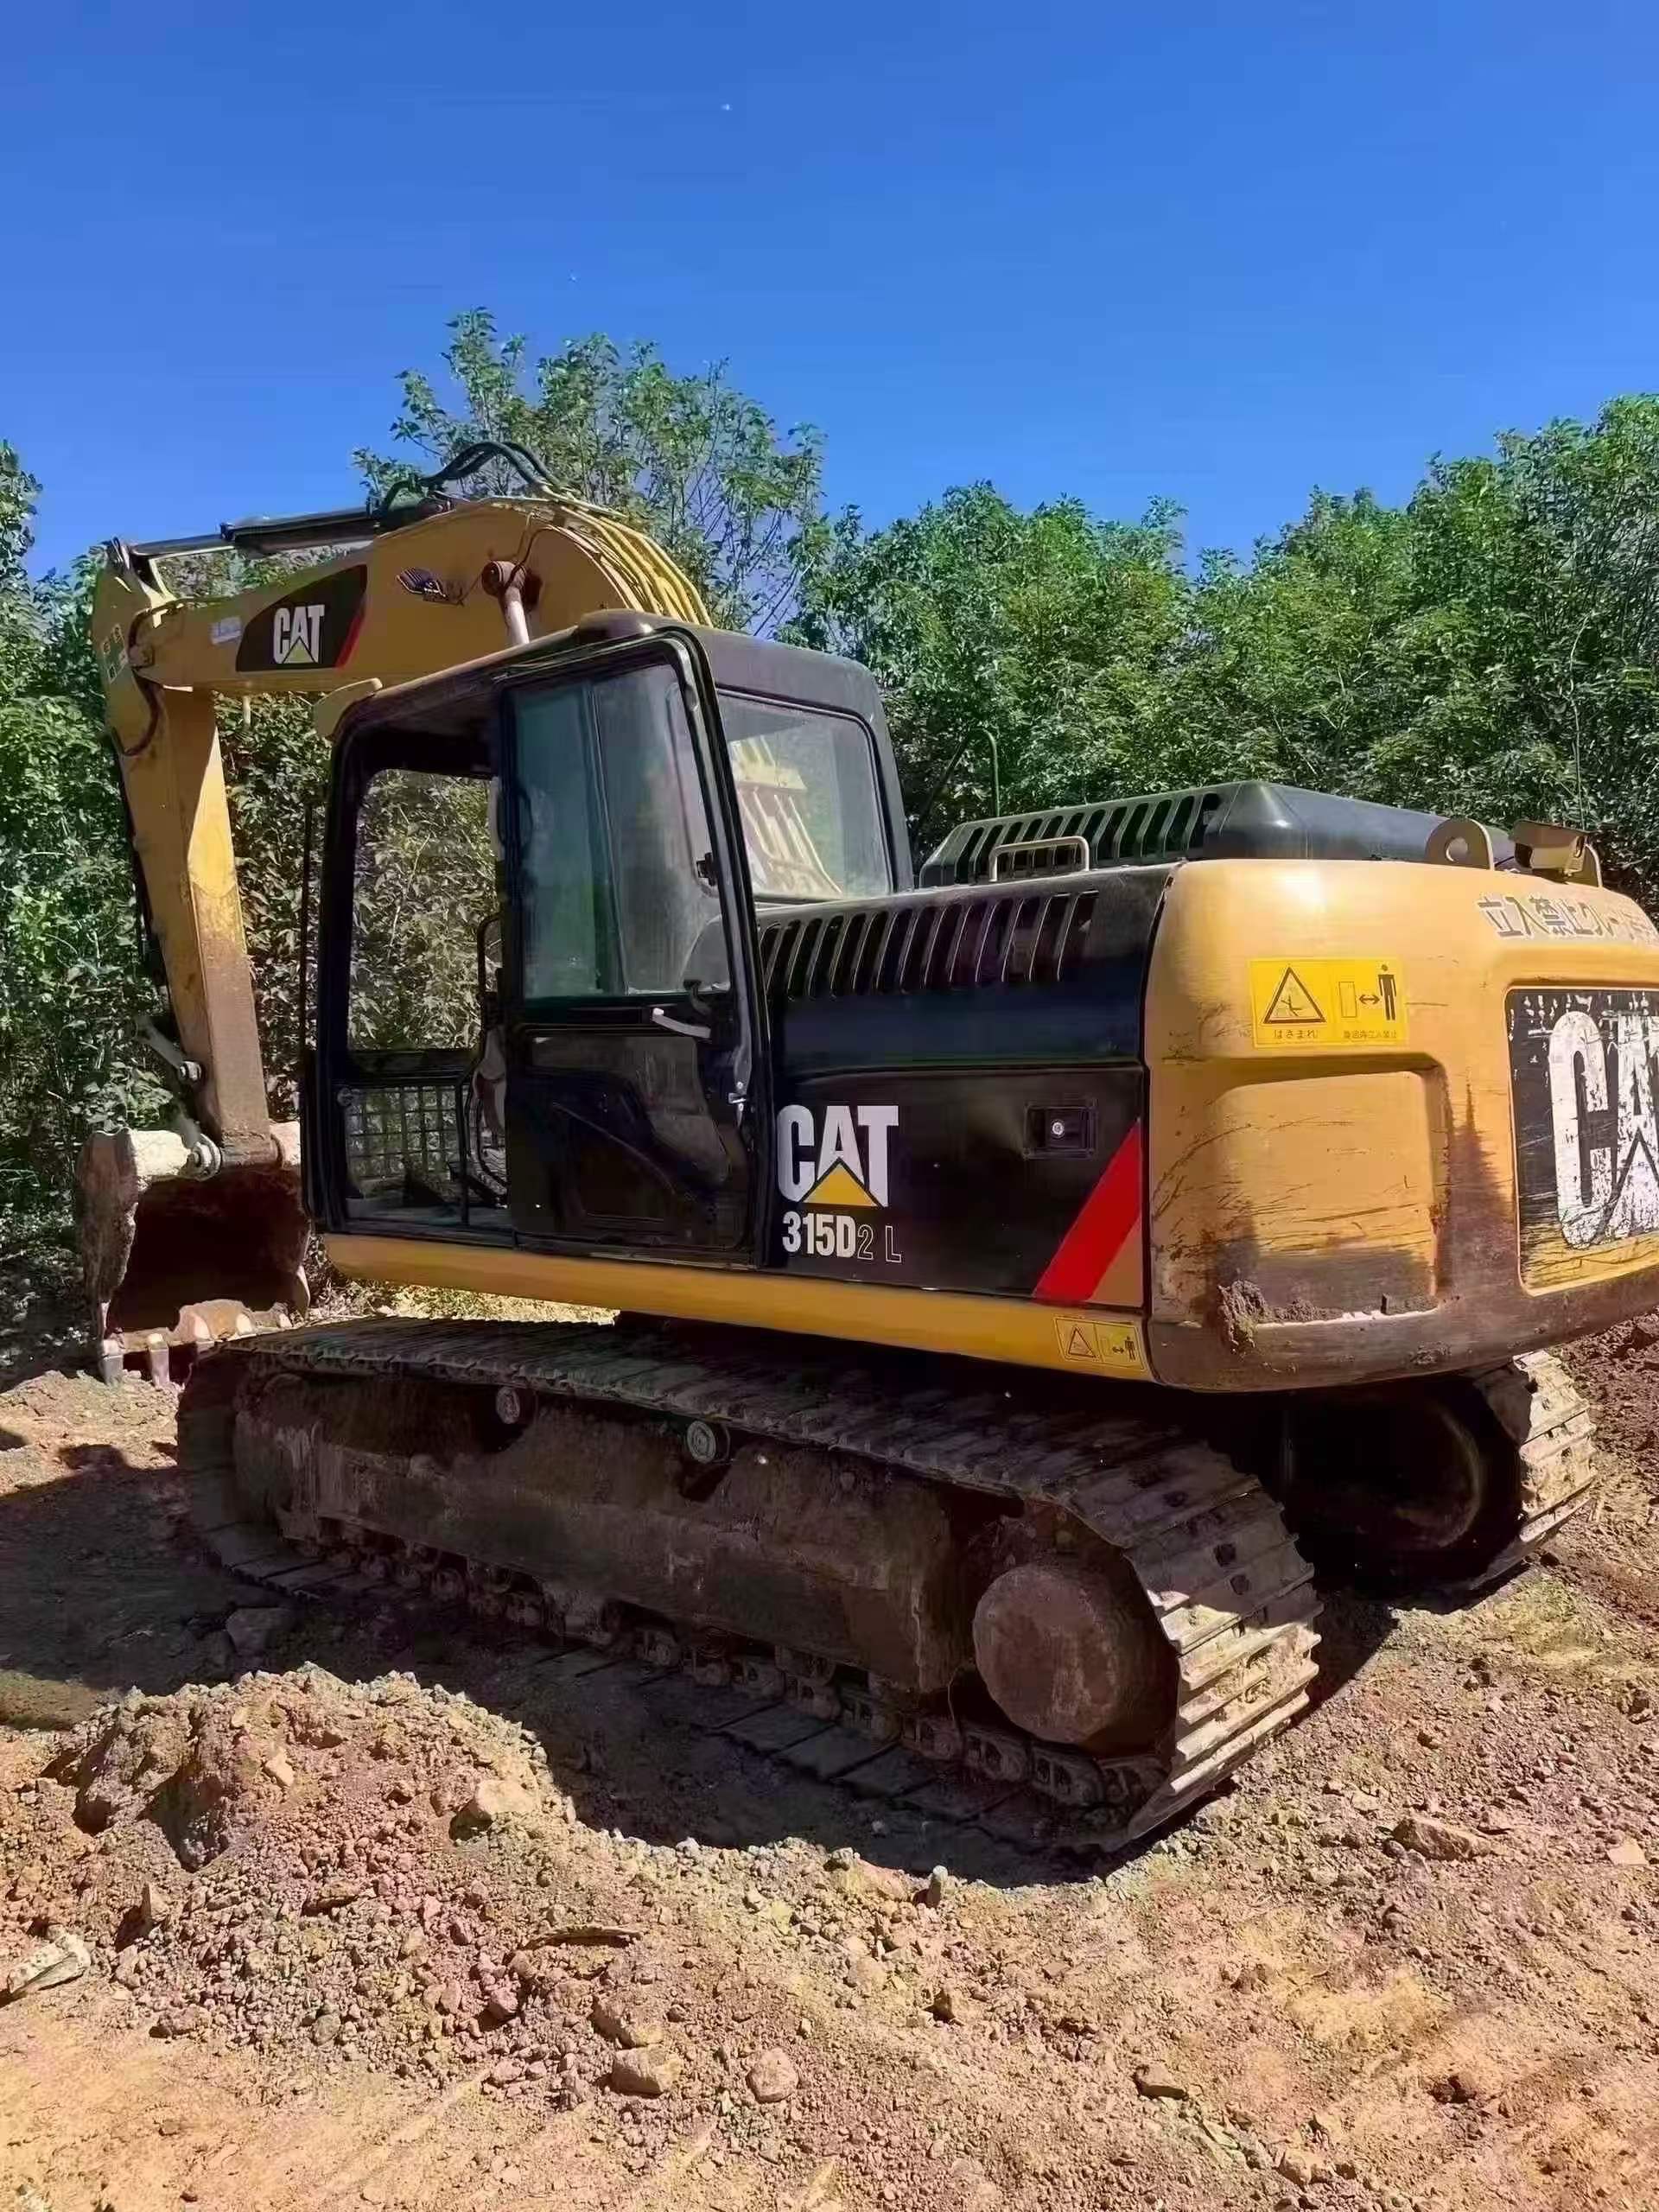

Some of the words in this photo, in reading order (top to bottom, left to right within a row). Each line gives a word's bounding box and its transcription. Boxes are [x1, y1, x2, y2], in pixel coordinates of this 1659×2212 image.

[273, 604, 325, 664] CAT
[777, 1104, 899, 1208] CAT
[1548, 1011, 1659, 1250] CA
[885, 1224, 902, 1263] L
